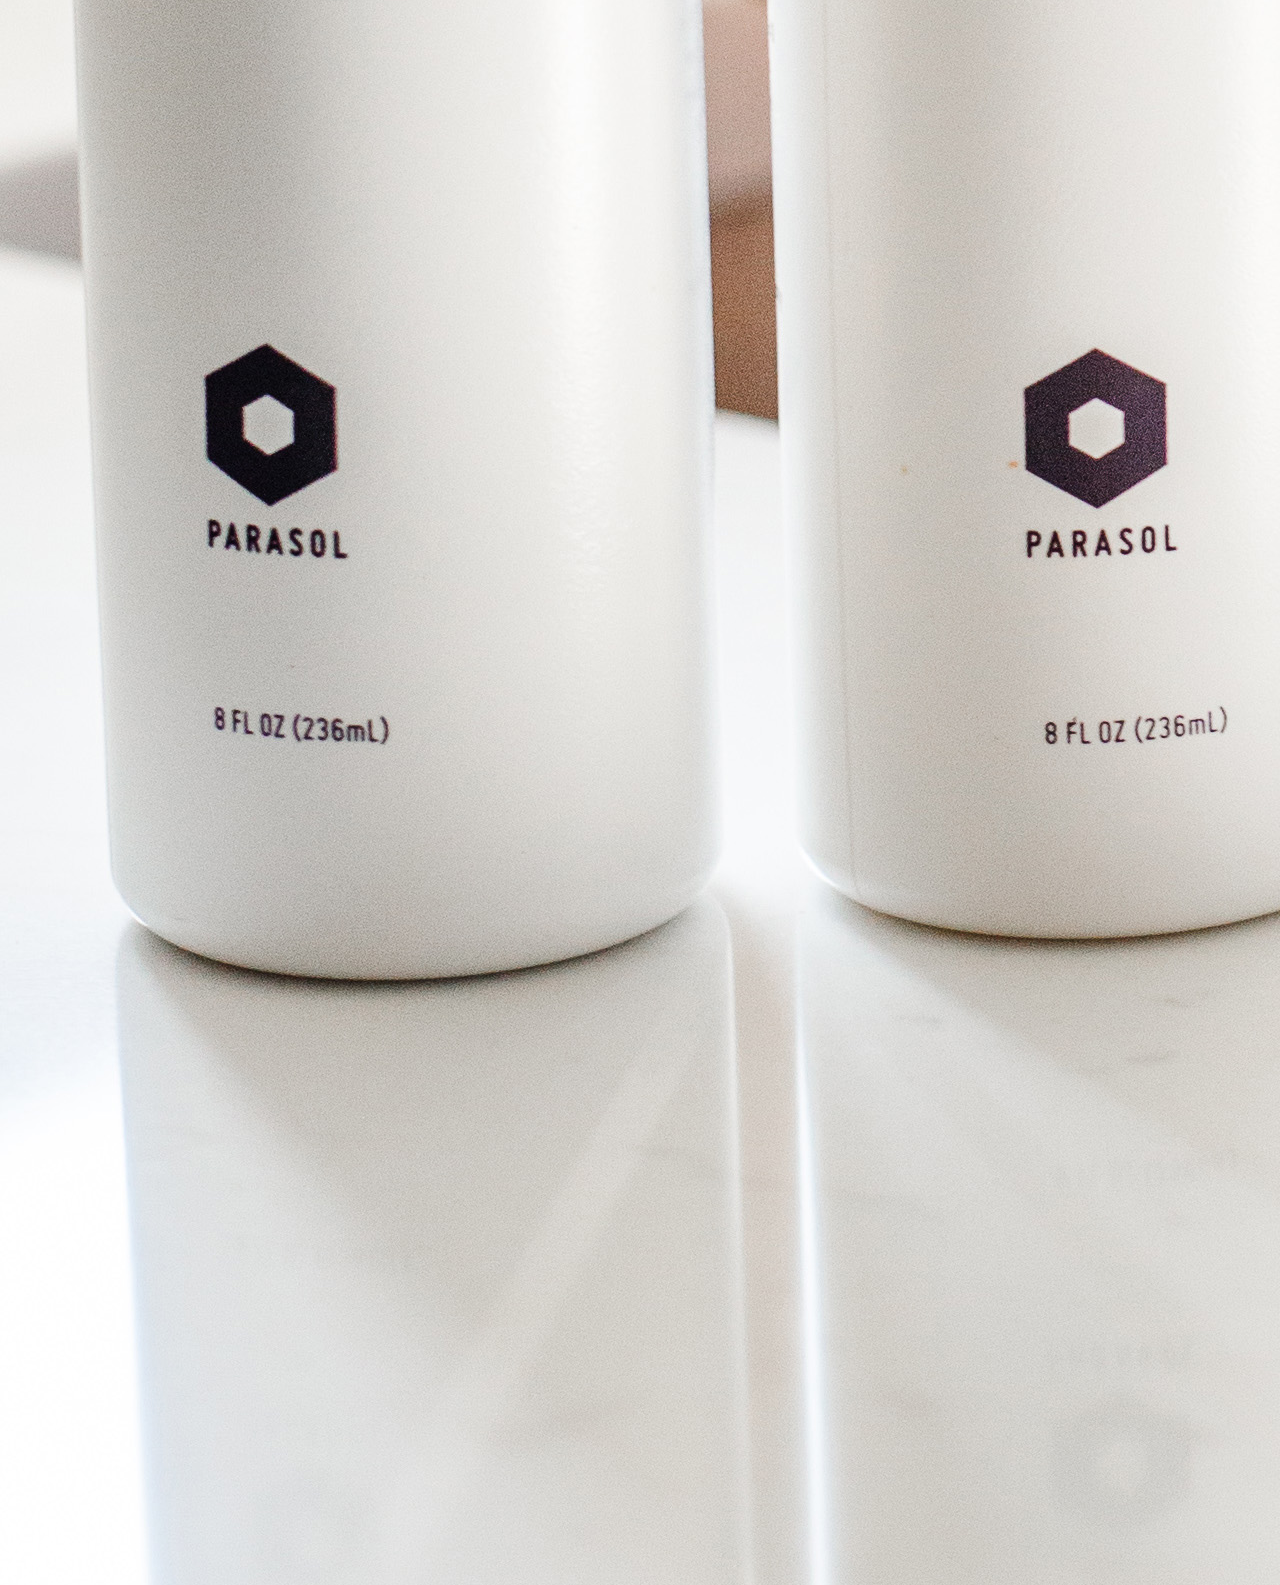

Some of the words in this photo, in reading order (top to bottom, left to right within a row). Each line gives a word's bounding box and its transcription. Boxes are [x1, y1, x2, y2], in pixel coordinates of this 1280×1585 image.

[207, 518, 348, 560] PARASOL
[1026, 523, 1178, 559] PARASOL
[214, 705, 226, 731] 8
[231, 709, 253, 736] FL
[260, 713, 286, 739] OZ
[292, 713, 390, 745] (236mL)
[1044, 721, 1059, 745] 8
[1066, 719, 1092, 745] FL
[1099, 718, 1127, 745] OZ
[1134, 706, 1229, 745] (236mL)
